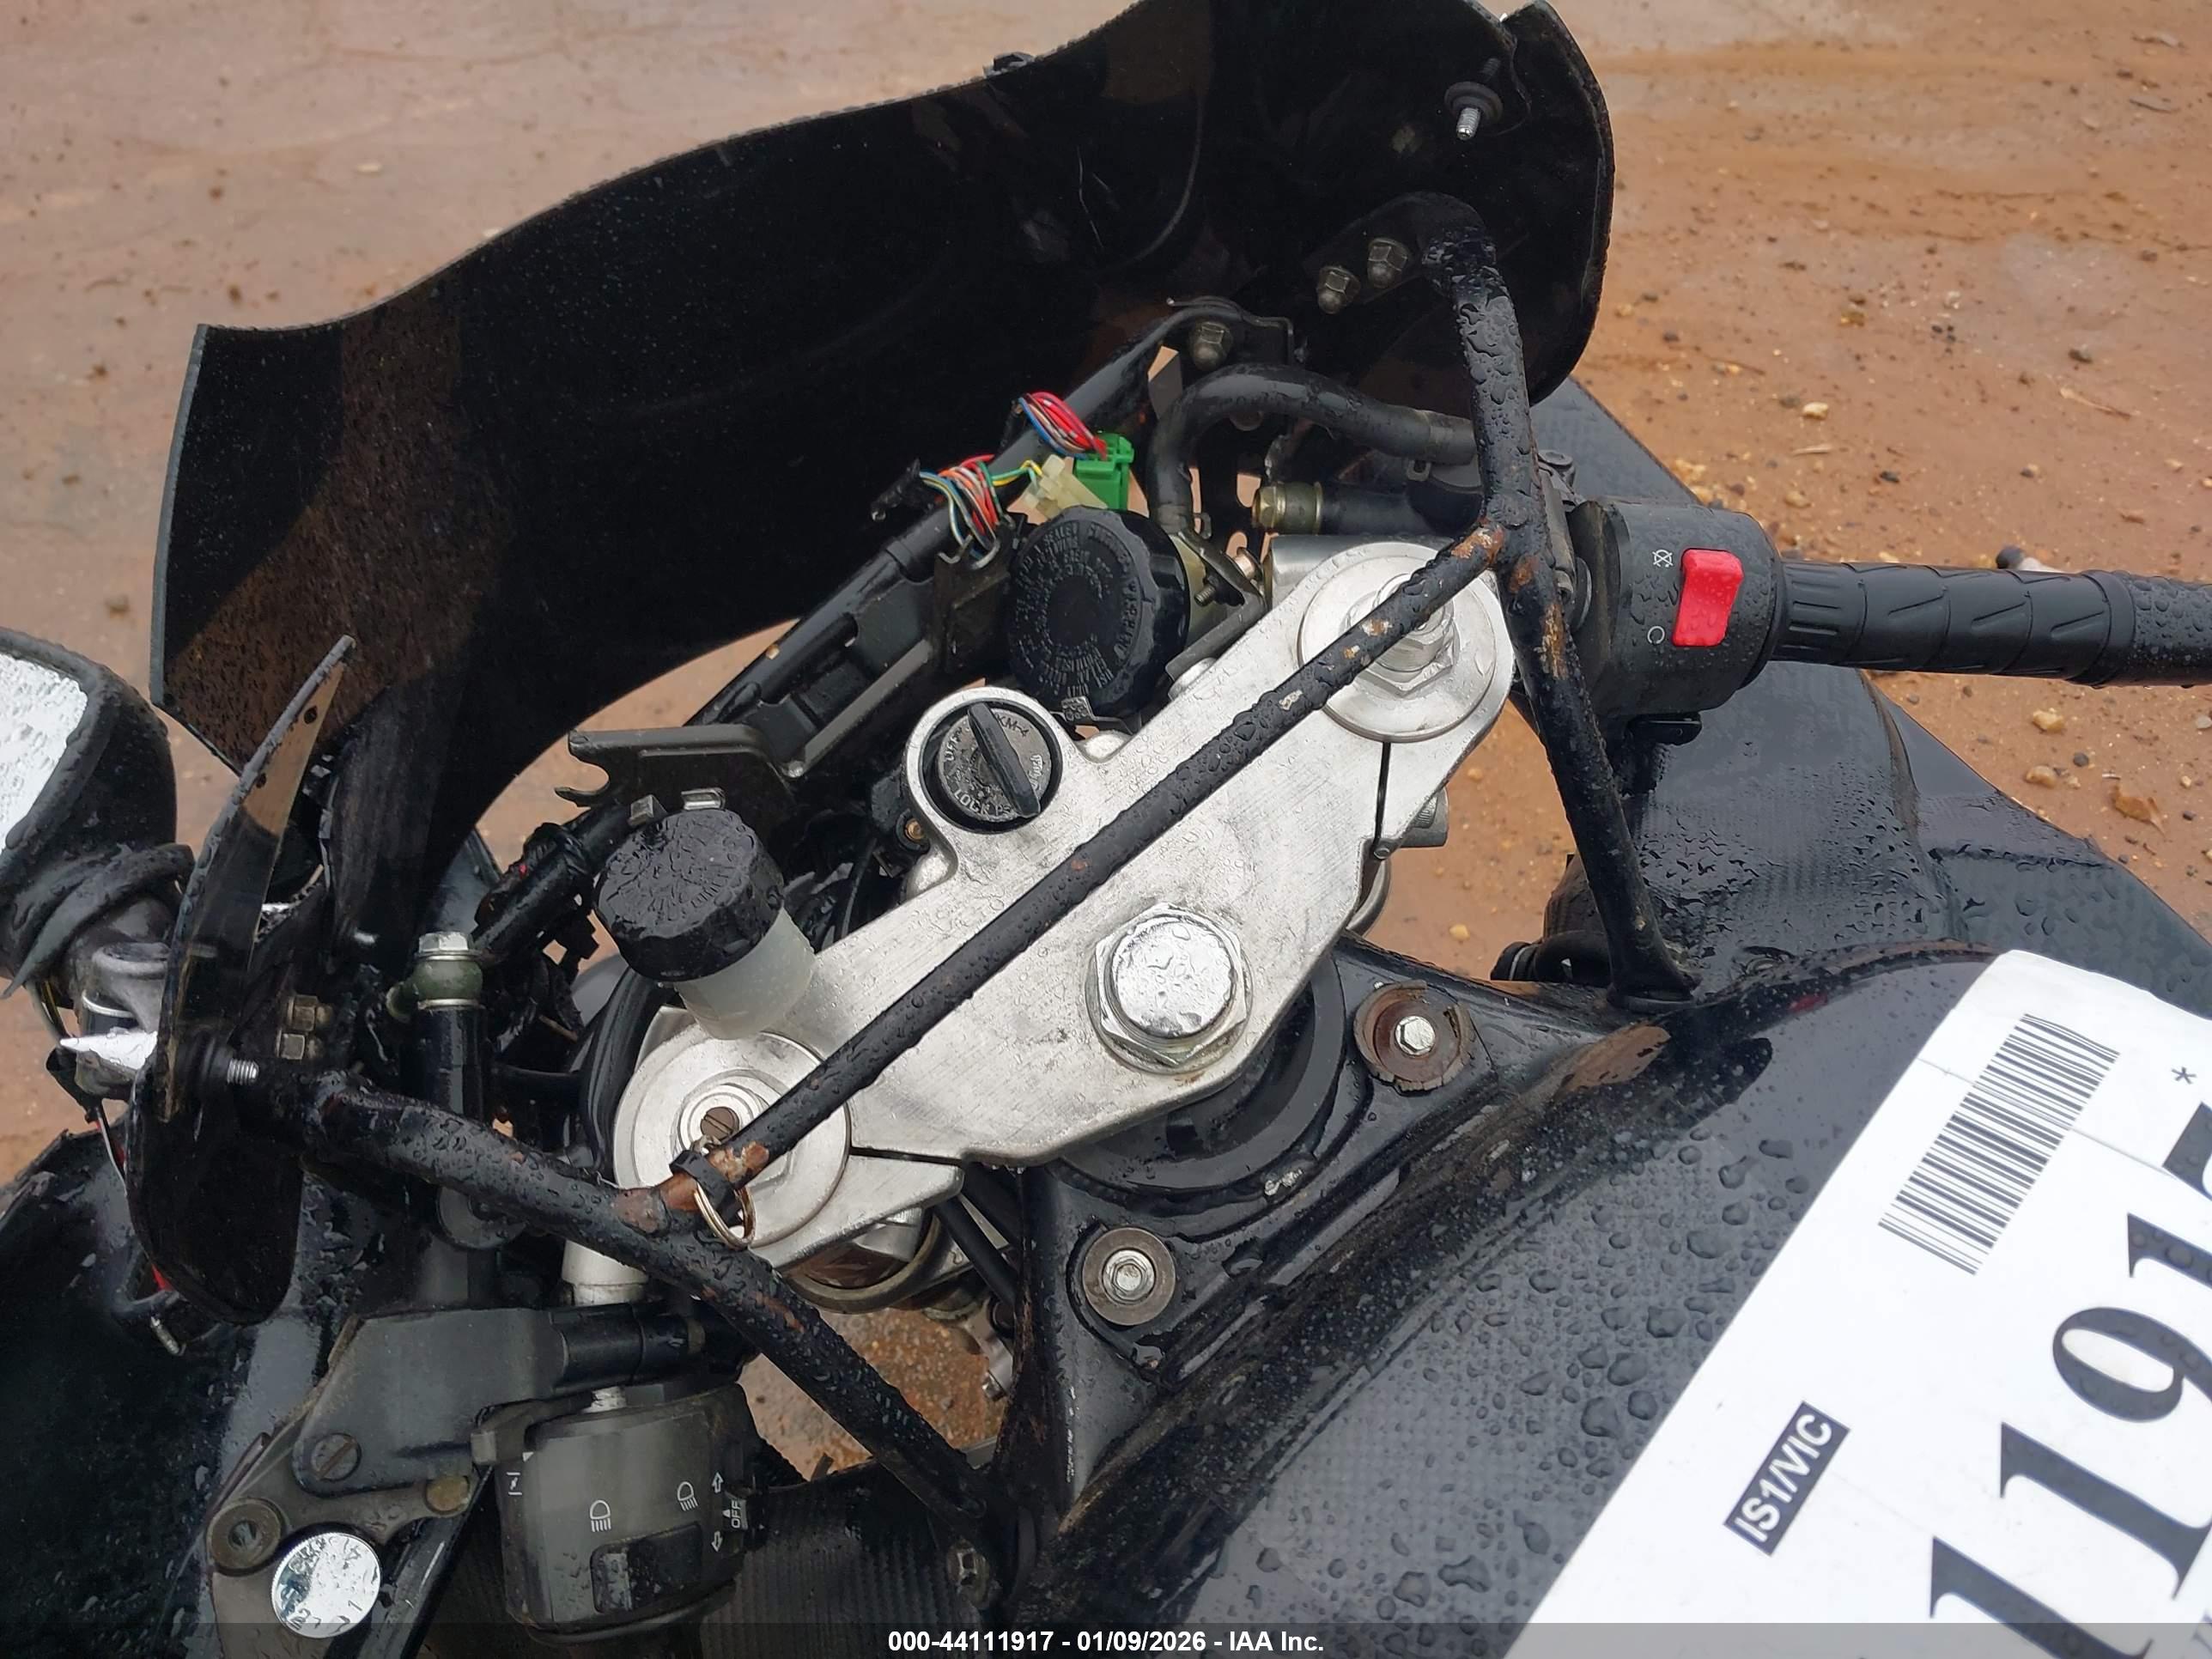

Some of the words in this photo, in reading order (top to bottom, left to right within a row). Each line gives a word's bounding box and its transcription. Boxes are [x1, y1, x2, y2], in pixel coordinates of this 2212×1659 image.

[953, 788, 989, 818] LOCK
[1734, 1413, 1833, 1543] IS1/VIC
[731, 1499, 742, 1528] OFF
